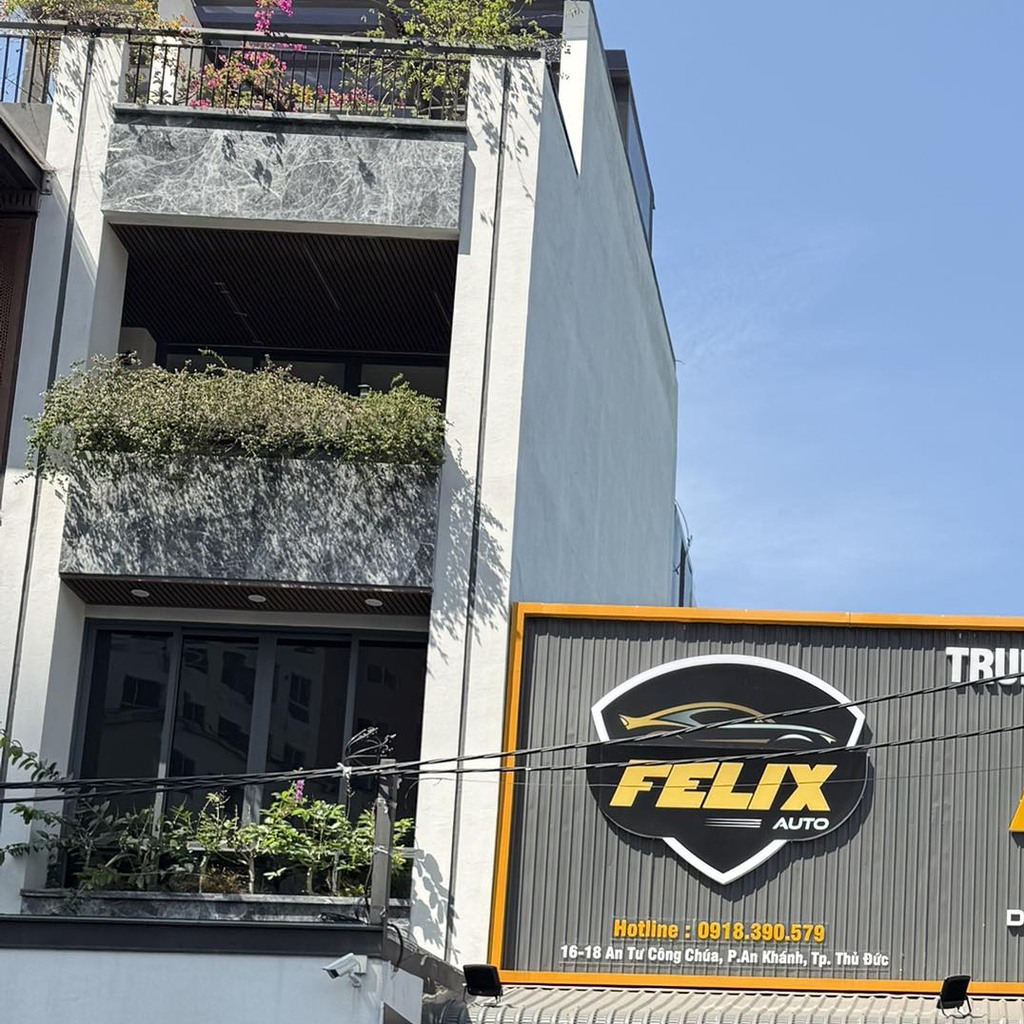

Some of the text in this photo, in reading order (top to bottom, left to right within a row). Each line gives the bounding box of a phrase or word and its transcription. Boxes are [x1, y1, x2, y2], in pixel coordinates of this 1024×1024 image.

[609, 760, 838, 812] FELIX
[773, 817, 830, 831] AUTO
[613, 919, 678, 939] Hotline
[697, 921, 825, 943] 0918.390.579
[561, 945, 601, 959] 16-18
[627, 946, 645, 960] Tư
[648, 947, 682, 964] Công
[685, 948, 723, 964] Chúa,
[727, 949, 758, 964] P.An
[762, 950, 807, 967] Khánh,
[811, 952, 831, 967] Tp.
[835, 951, 859, 966] Thủ
[863, 952, 889, 966] Đức
